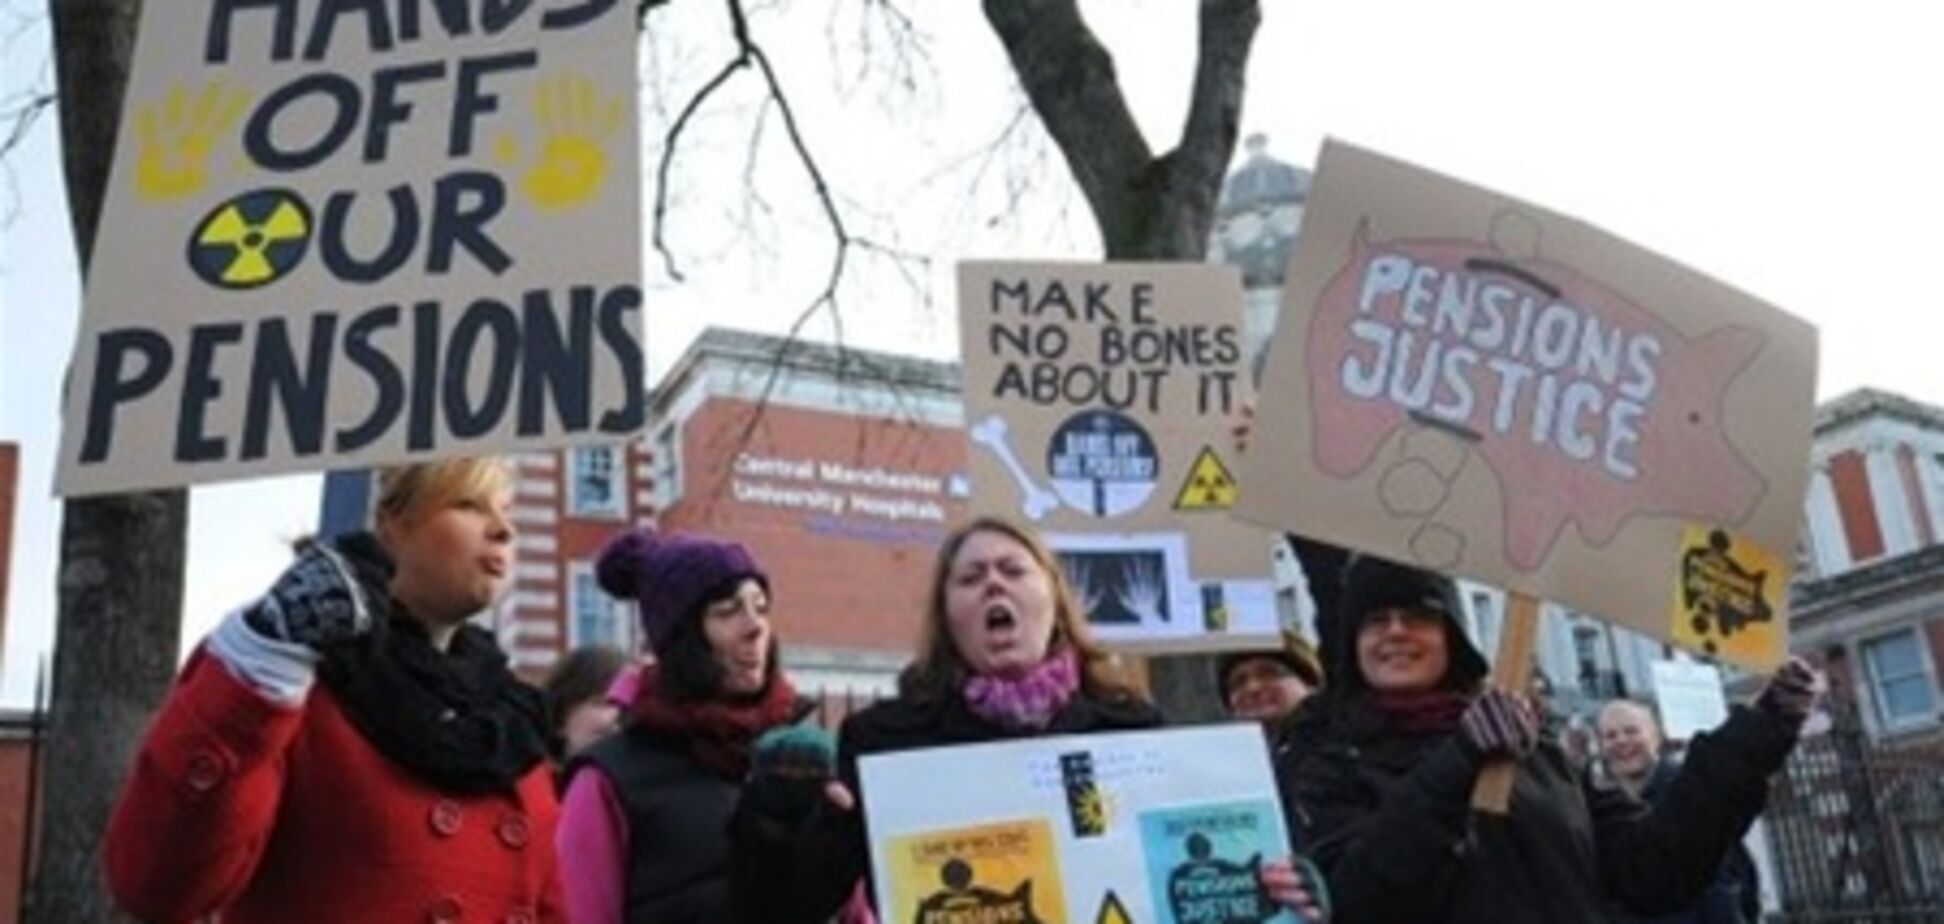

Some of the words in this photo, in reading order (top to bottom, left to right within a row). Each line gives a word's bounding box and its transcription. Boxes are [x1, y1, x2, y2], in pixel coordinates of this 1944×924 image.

[243, 50, 538, 171] OFF
[187, 171, 513, 290] OUR
[990, 278, 1157, 325] MAKE
[1360, 254, 1662, 401] PENSIONS
[79, 285, 648, 464] PENSIONS
[989, 323, 1069, 360] NO
[1100, 323, 1240, 367] BONES
[993, 361, 1169, 414] ABOUT
[1199, 370, 1237, 415] IT
[1340, 318, 1641, 480] JUSTICE
[732, 478, 844, 515] University
[850, 493, 945, 521] Hospitals
[733, 452, 814, 479] Central
[820, 460, 943, 493] Manchester
